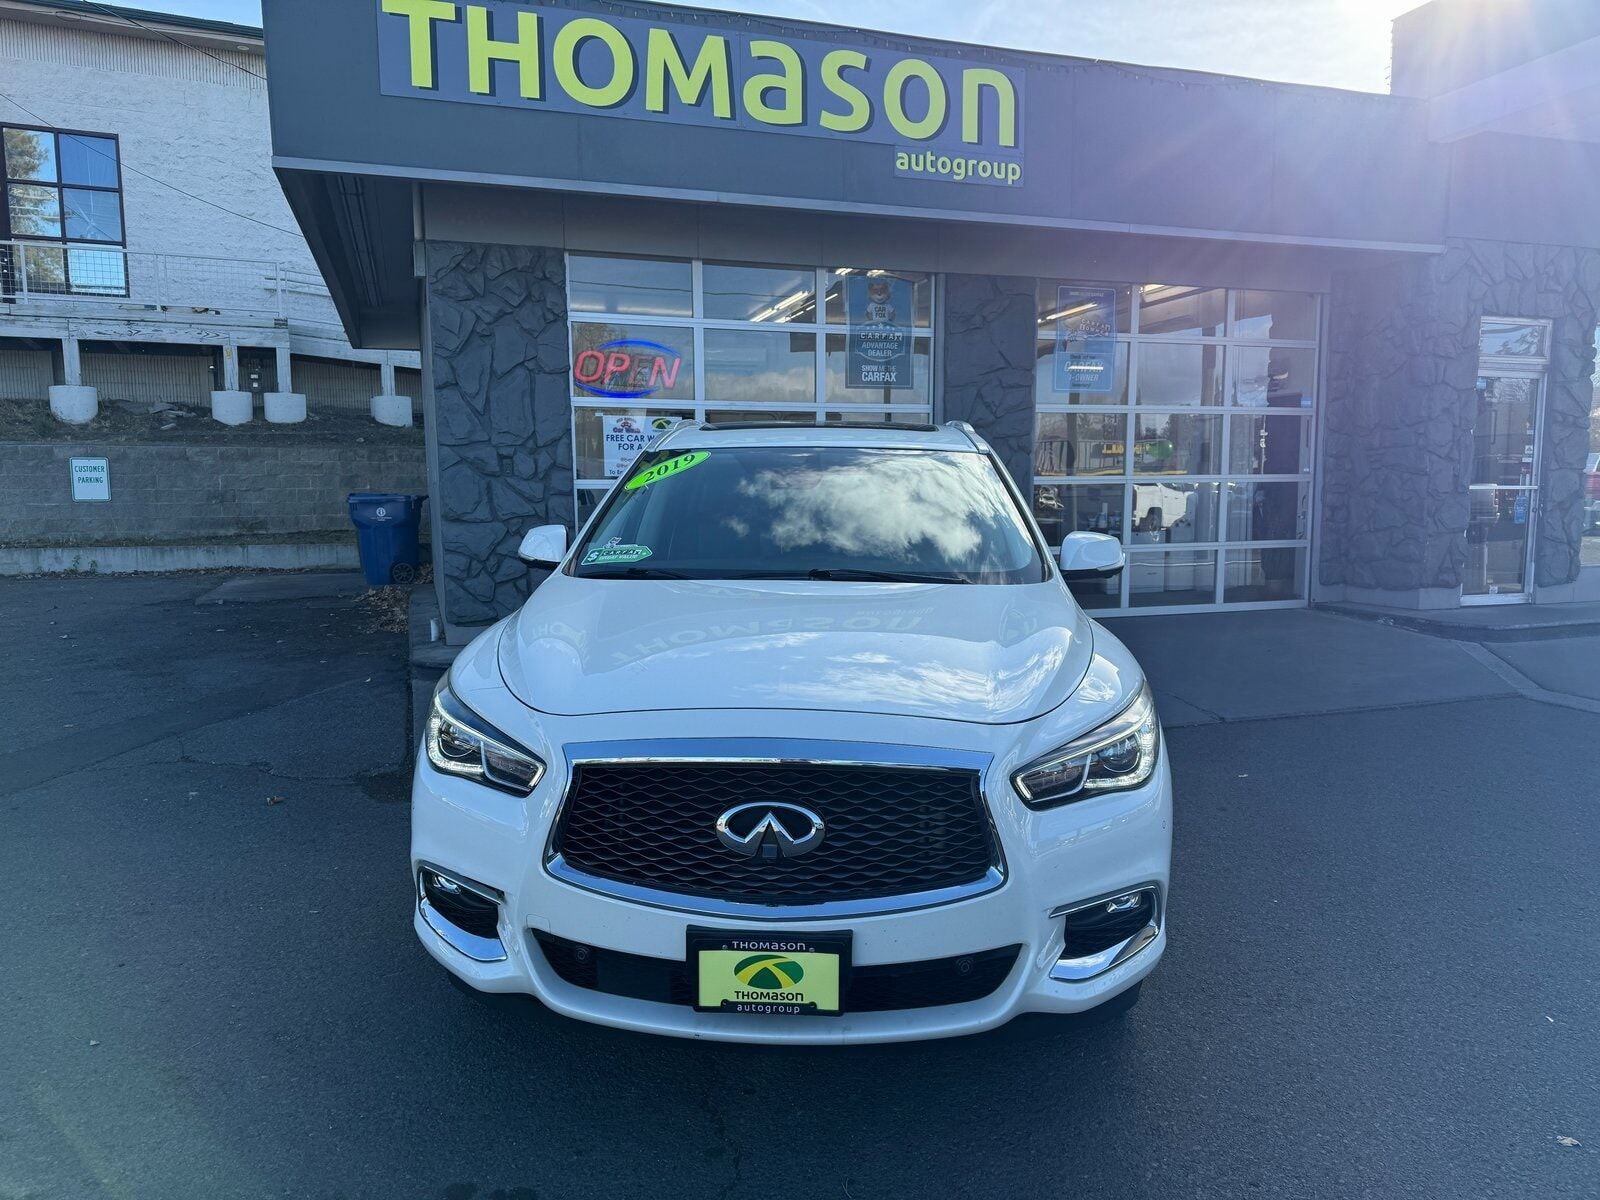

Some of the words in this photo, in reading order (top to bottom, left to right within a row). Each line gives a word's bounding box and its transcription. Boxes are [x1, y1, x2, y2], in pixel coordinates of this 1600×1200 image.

[896, 151, 1021, 185] autogroup
[860, 332, 903, 341] CARFAX
[861, 341, 898, 350] ADVANTAGE
[867, 349, 892, 357] DEALER
[574, 350, 681, 388] OPEN
[861, 372, 897, 382] CARFAX
[606, 434, 625, 442] FREE
[626, 434, 645, 442] CAR
[618, 443, 635, 451] FOR
[643, 454, 695, 483] 2019
[732, 940, 806, 951] THOMason
[734, 990, 804, 1001] THOMason
[737, 1003, 801, 1014] autogroup
